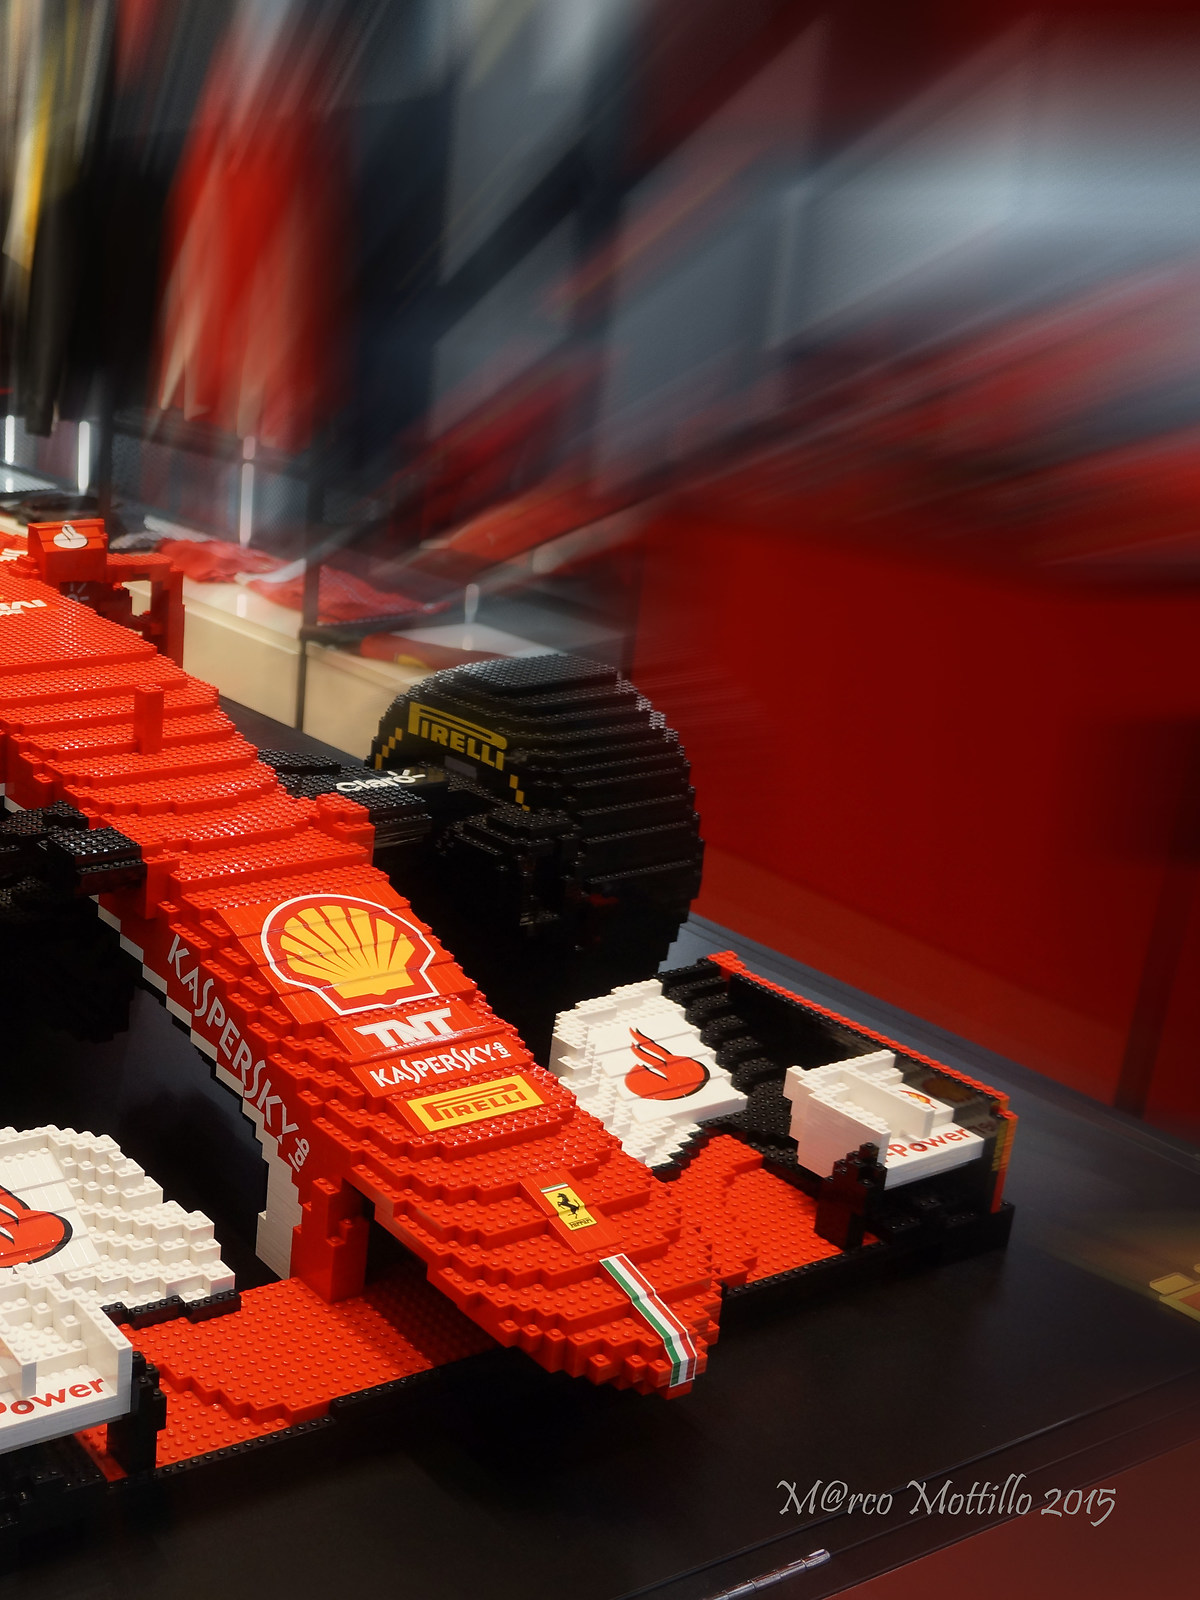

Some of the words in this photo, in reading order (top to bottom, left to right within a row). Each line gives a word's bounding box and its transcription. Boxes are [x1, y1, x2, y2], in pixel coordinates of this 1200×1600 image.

[407, 701, 508, 771] PIRELLI
[336, 773, 419, 792] Claro
[352, 1007, 452, 1048] TNT
[167, 933, 300, 1145] KASPERSKY
[287, 1137, 310, 1173] lab
[369, 1043, 497, 1088] KASPERSKY
[492, 1041, 512, 1059] lab
[421, 1083, 528, 1123] PIRELLI
